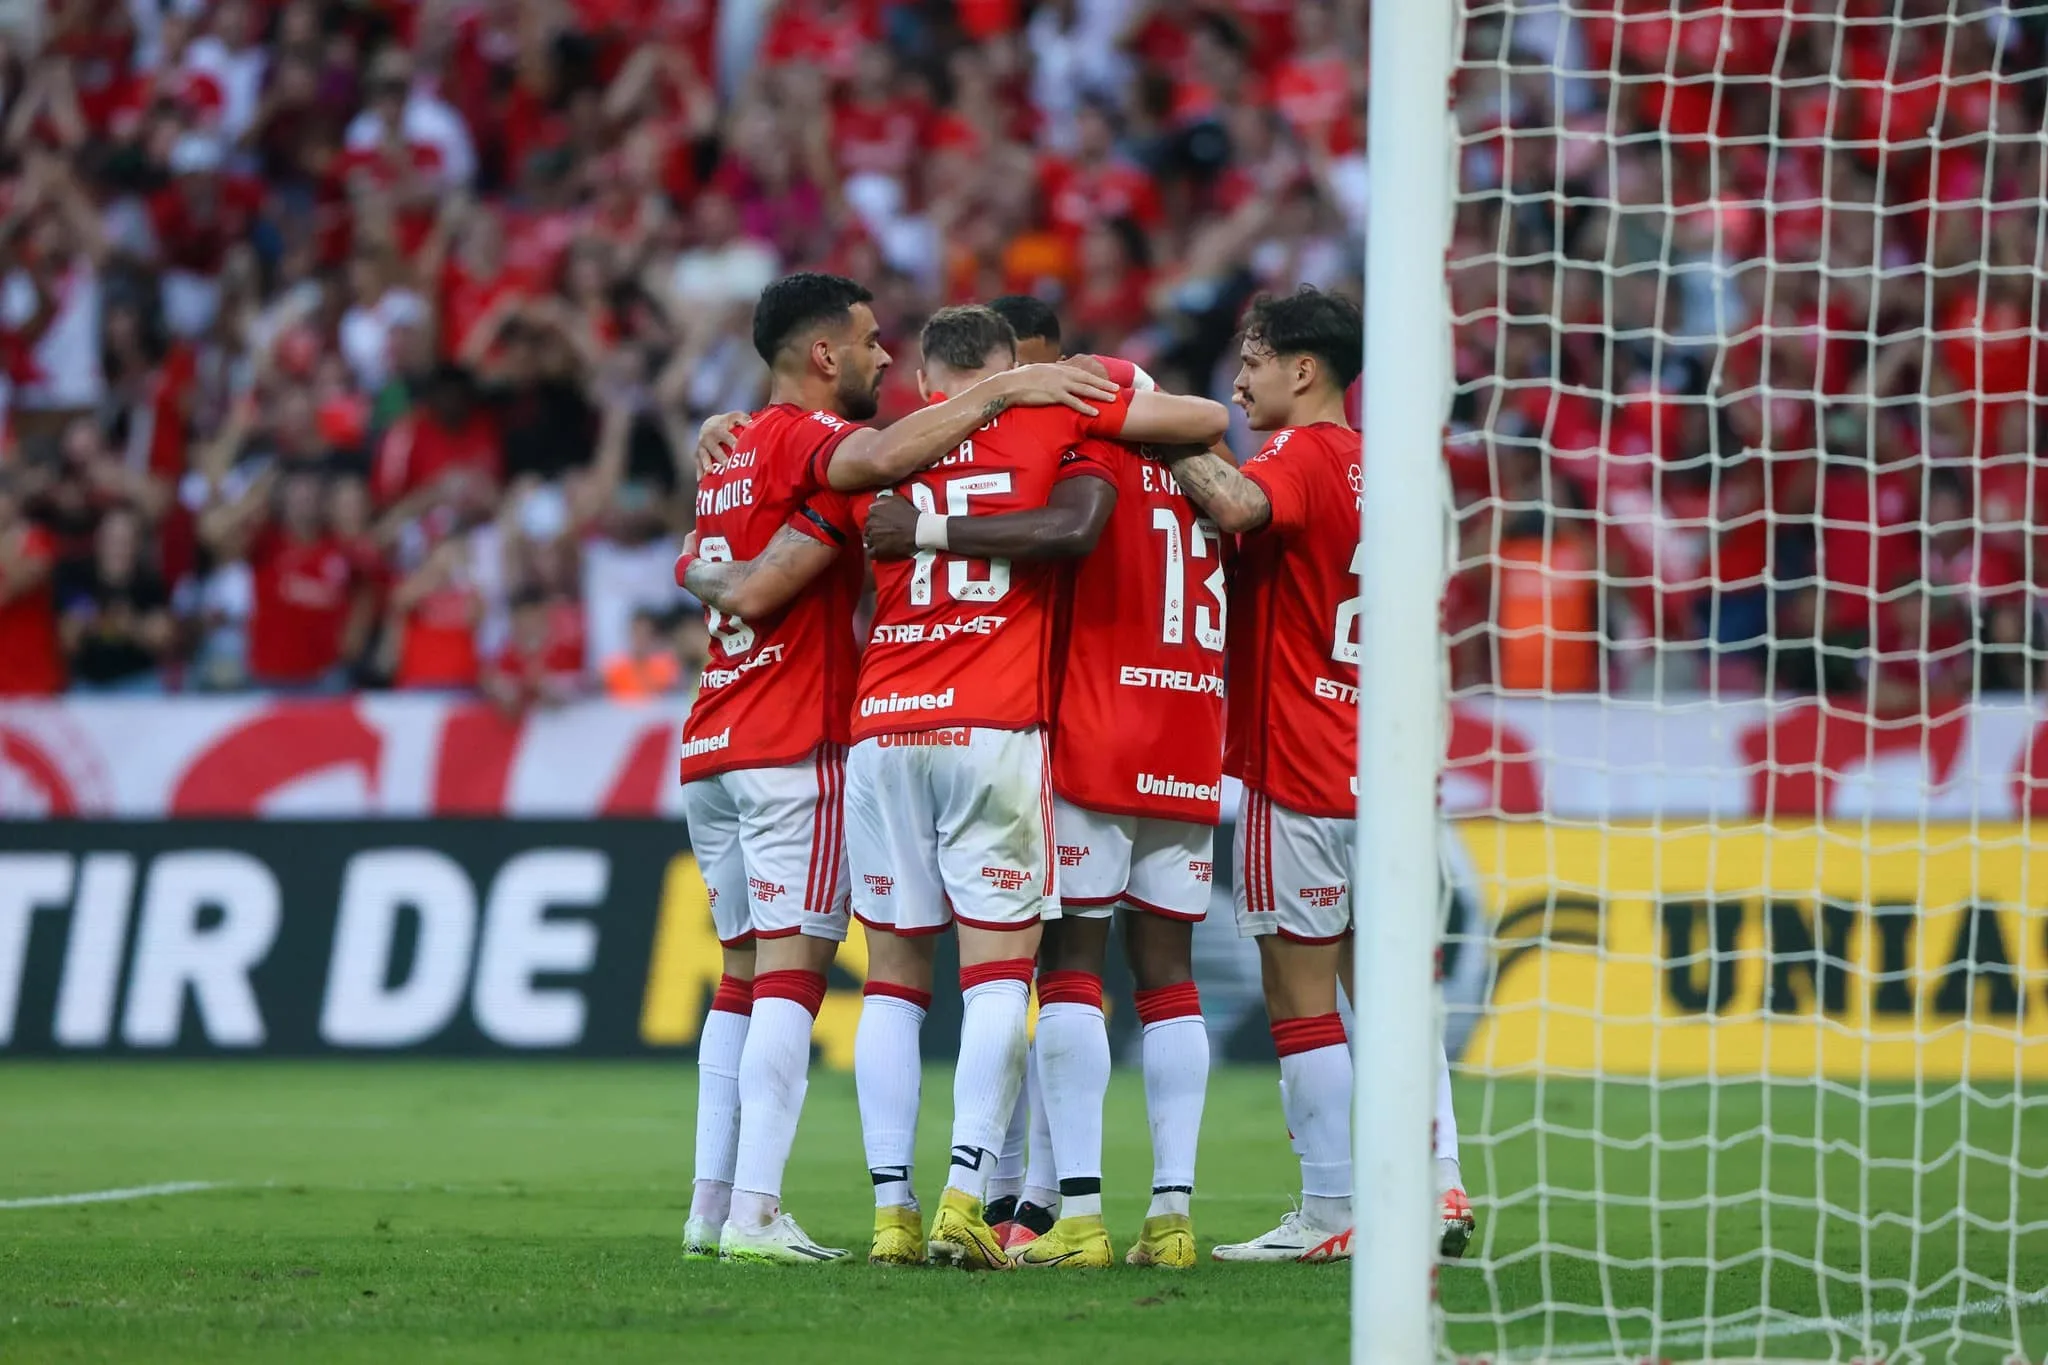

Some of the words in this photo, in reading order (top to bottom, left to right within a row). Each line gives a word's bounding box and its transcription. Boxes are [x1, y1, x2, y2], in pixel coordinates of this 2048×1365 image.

[1153, 508, 1227, 652] 13
[870, 624, 946, 644] STRELA
[860, 688, 955, 718] Unimed
[681, 726, 731, 759] nimed
[1136, 772, 1220, 802] Unimed
[1056, 845, 1091, 856] TRELA
[1060, 855, 1083, 866] BET
[982, 866, 1033, 881] ESTRELA
[874, 885, 891, 896] BET
[1000, 879, 1024, 891] BET
[1299, 884, 1346, 898] ESTRELA
[758, 890, 777, 903] BET
[1319, 895, 1340, 907] BET
[318, 848, 610, 1049] DE
[1661, 897, 2048, 1016] UNIA
